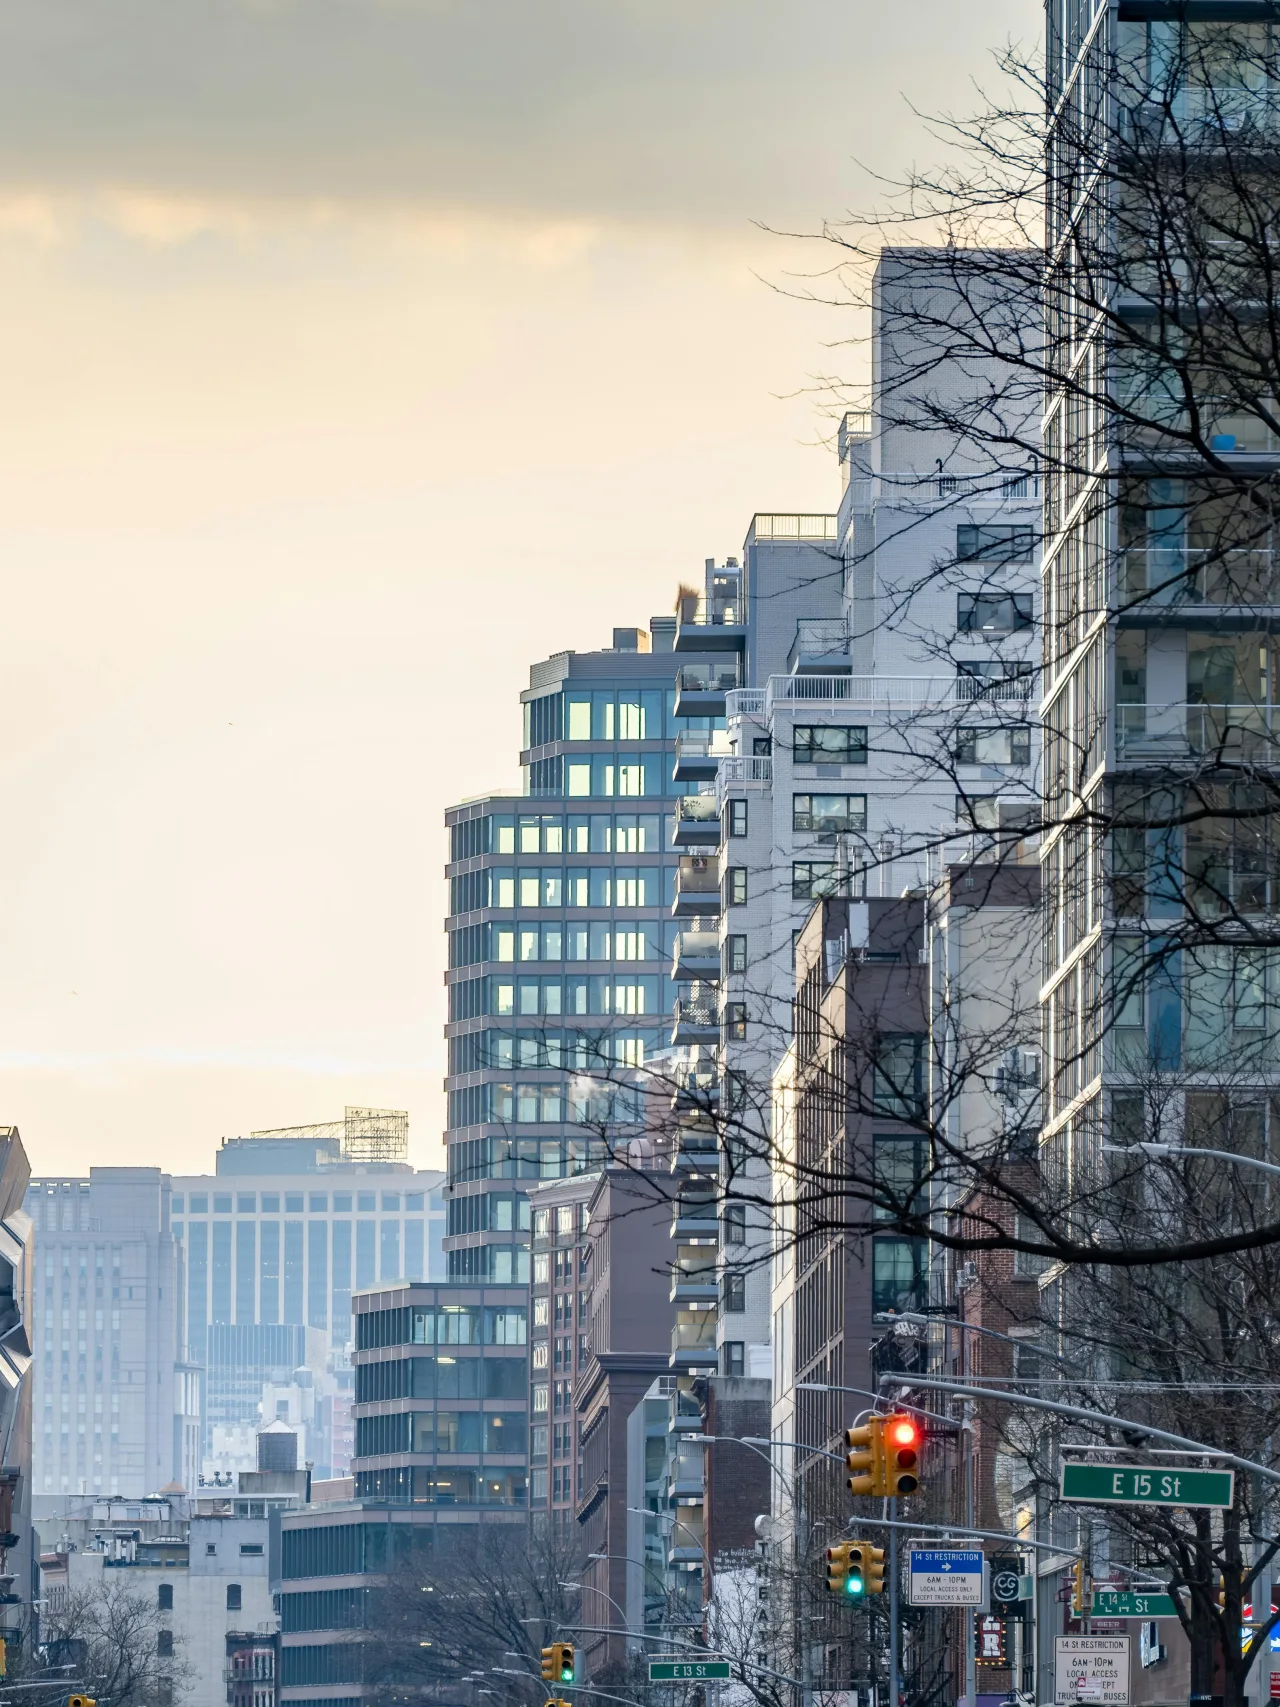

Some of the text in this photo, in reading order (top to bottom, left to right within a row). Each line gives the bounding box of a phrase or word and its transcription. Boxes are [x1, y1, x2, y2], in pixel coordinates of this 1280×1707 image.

[1112, 1473, 1181, 1498] E 15 St
[925, 1553, 933, 1561] St
[934, 1553, 979, 1561] RESTRICTION
[927, 1576, 941, 1584] 6AM
[948, 1576, 967, 1584] 10PM
[997, 1577, 1017, 1588] CG
[1100, 1594, 1105, 1606] E
[1109, 1594, 1118, 1605] 14
[1135, 1599, 1149, 1613] St
[1062, 1640, 1124, 1649] 14 St RESTRICTION
[673, 1665, 707, 1677] E 13 St
[1066, 1670, 1119, 1678] LOCAL ACCESS
[1103, 1692, 1127, 1701] BUSES
